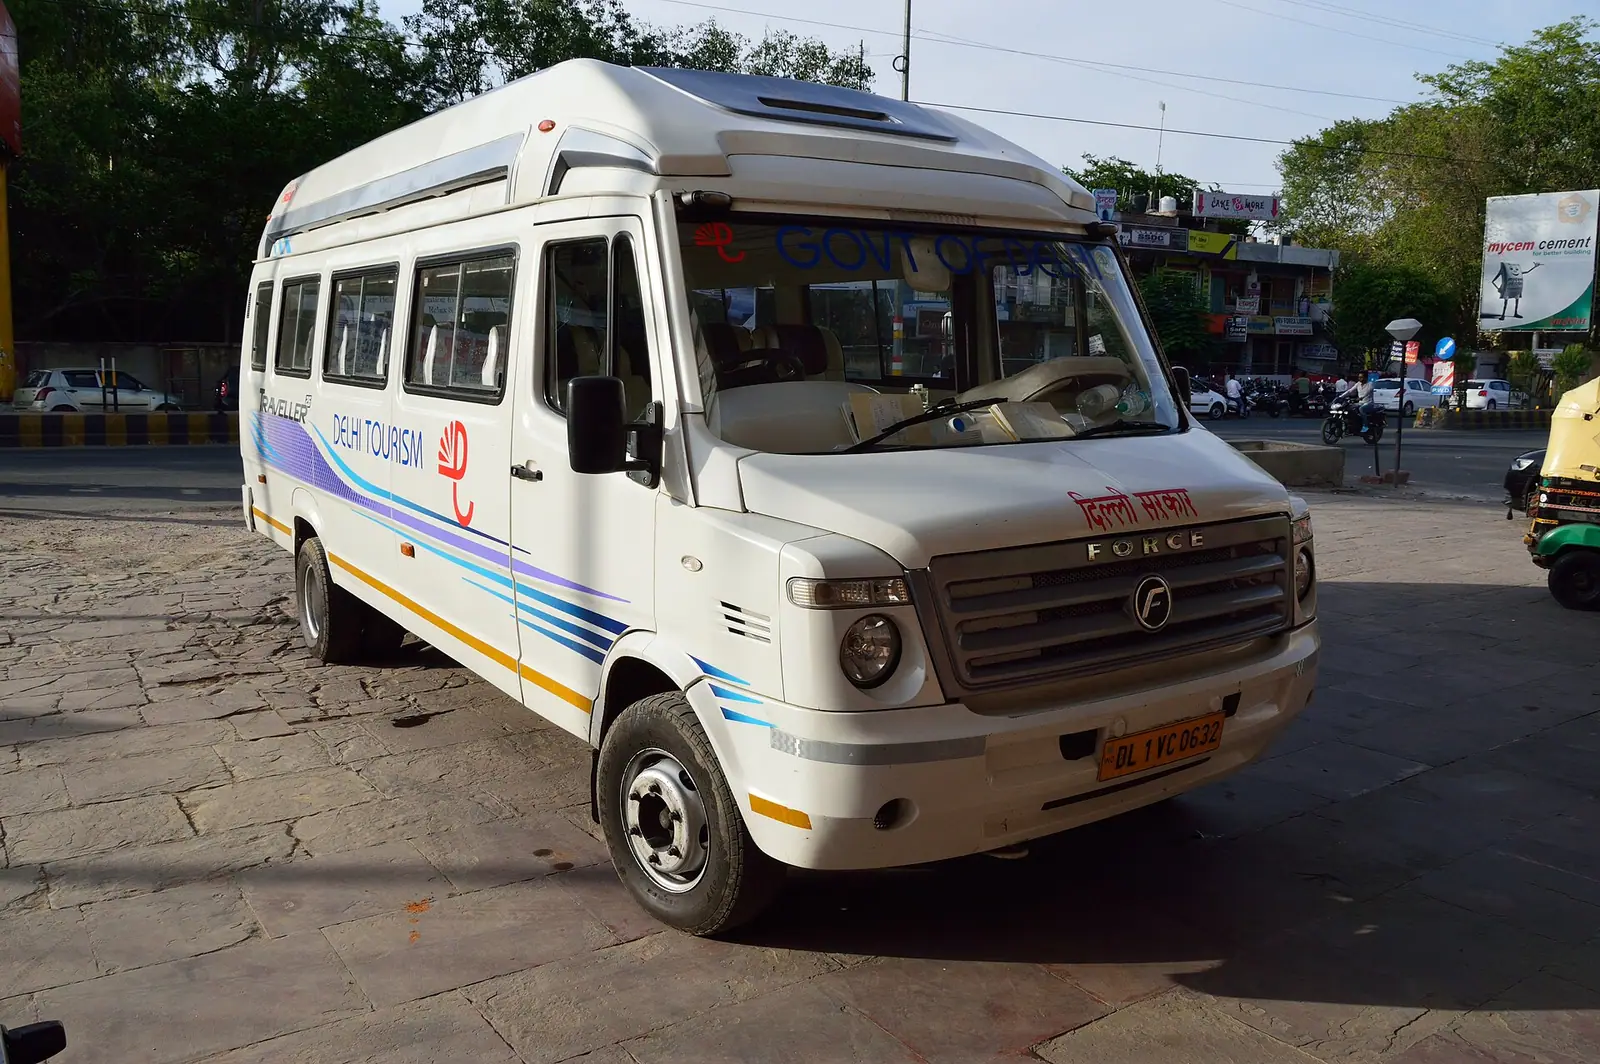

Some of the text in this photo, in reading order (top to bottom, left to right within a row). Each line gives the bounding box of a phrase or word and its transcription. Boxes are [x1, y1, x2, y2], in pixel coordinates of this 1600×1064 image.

[1211, 196, 1230, 211] CAKE
[1244, 198, 1264, 213] MORE
[775, 224, 919, 273] GOVT
[934, 234, 992, 277] OF
[1487, 235, 1592, 255] mycem cement
[259, 387, 308, 424] TRAVELLER
[333, 413, 424, 470] DELHI TOURISM
[1086, 529, 1204, 562] FORCE
